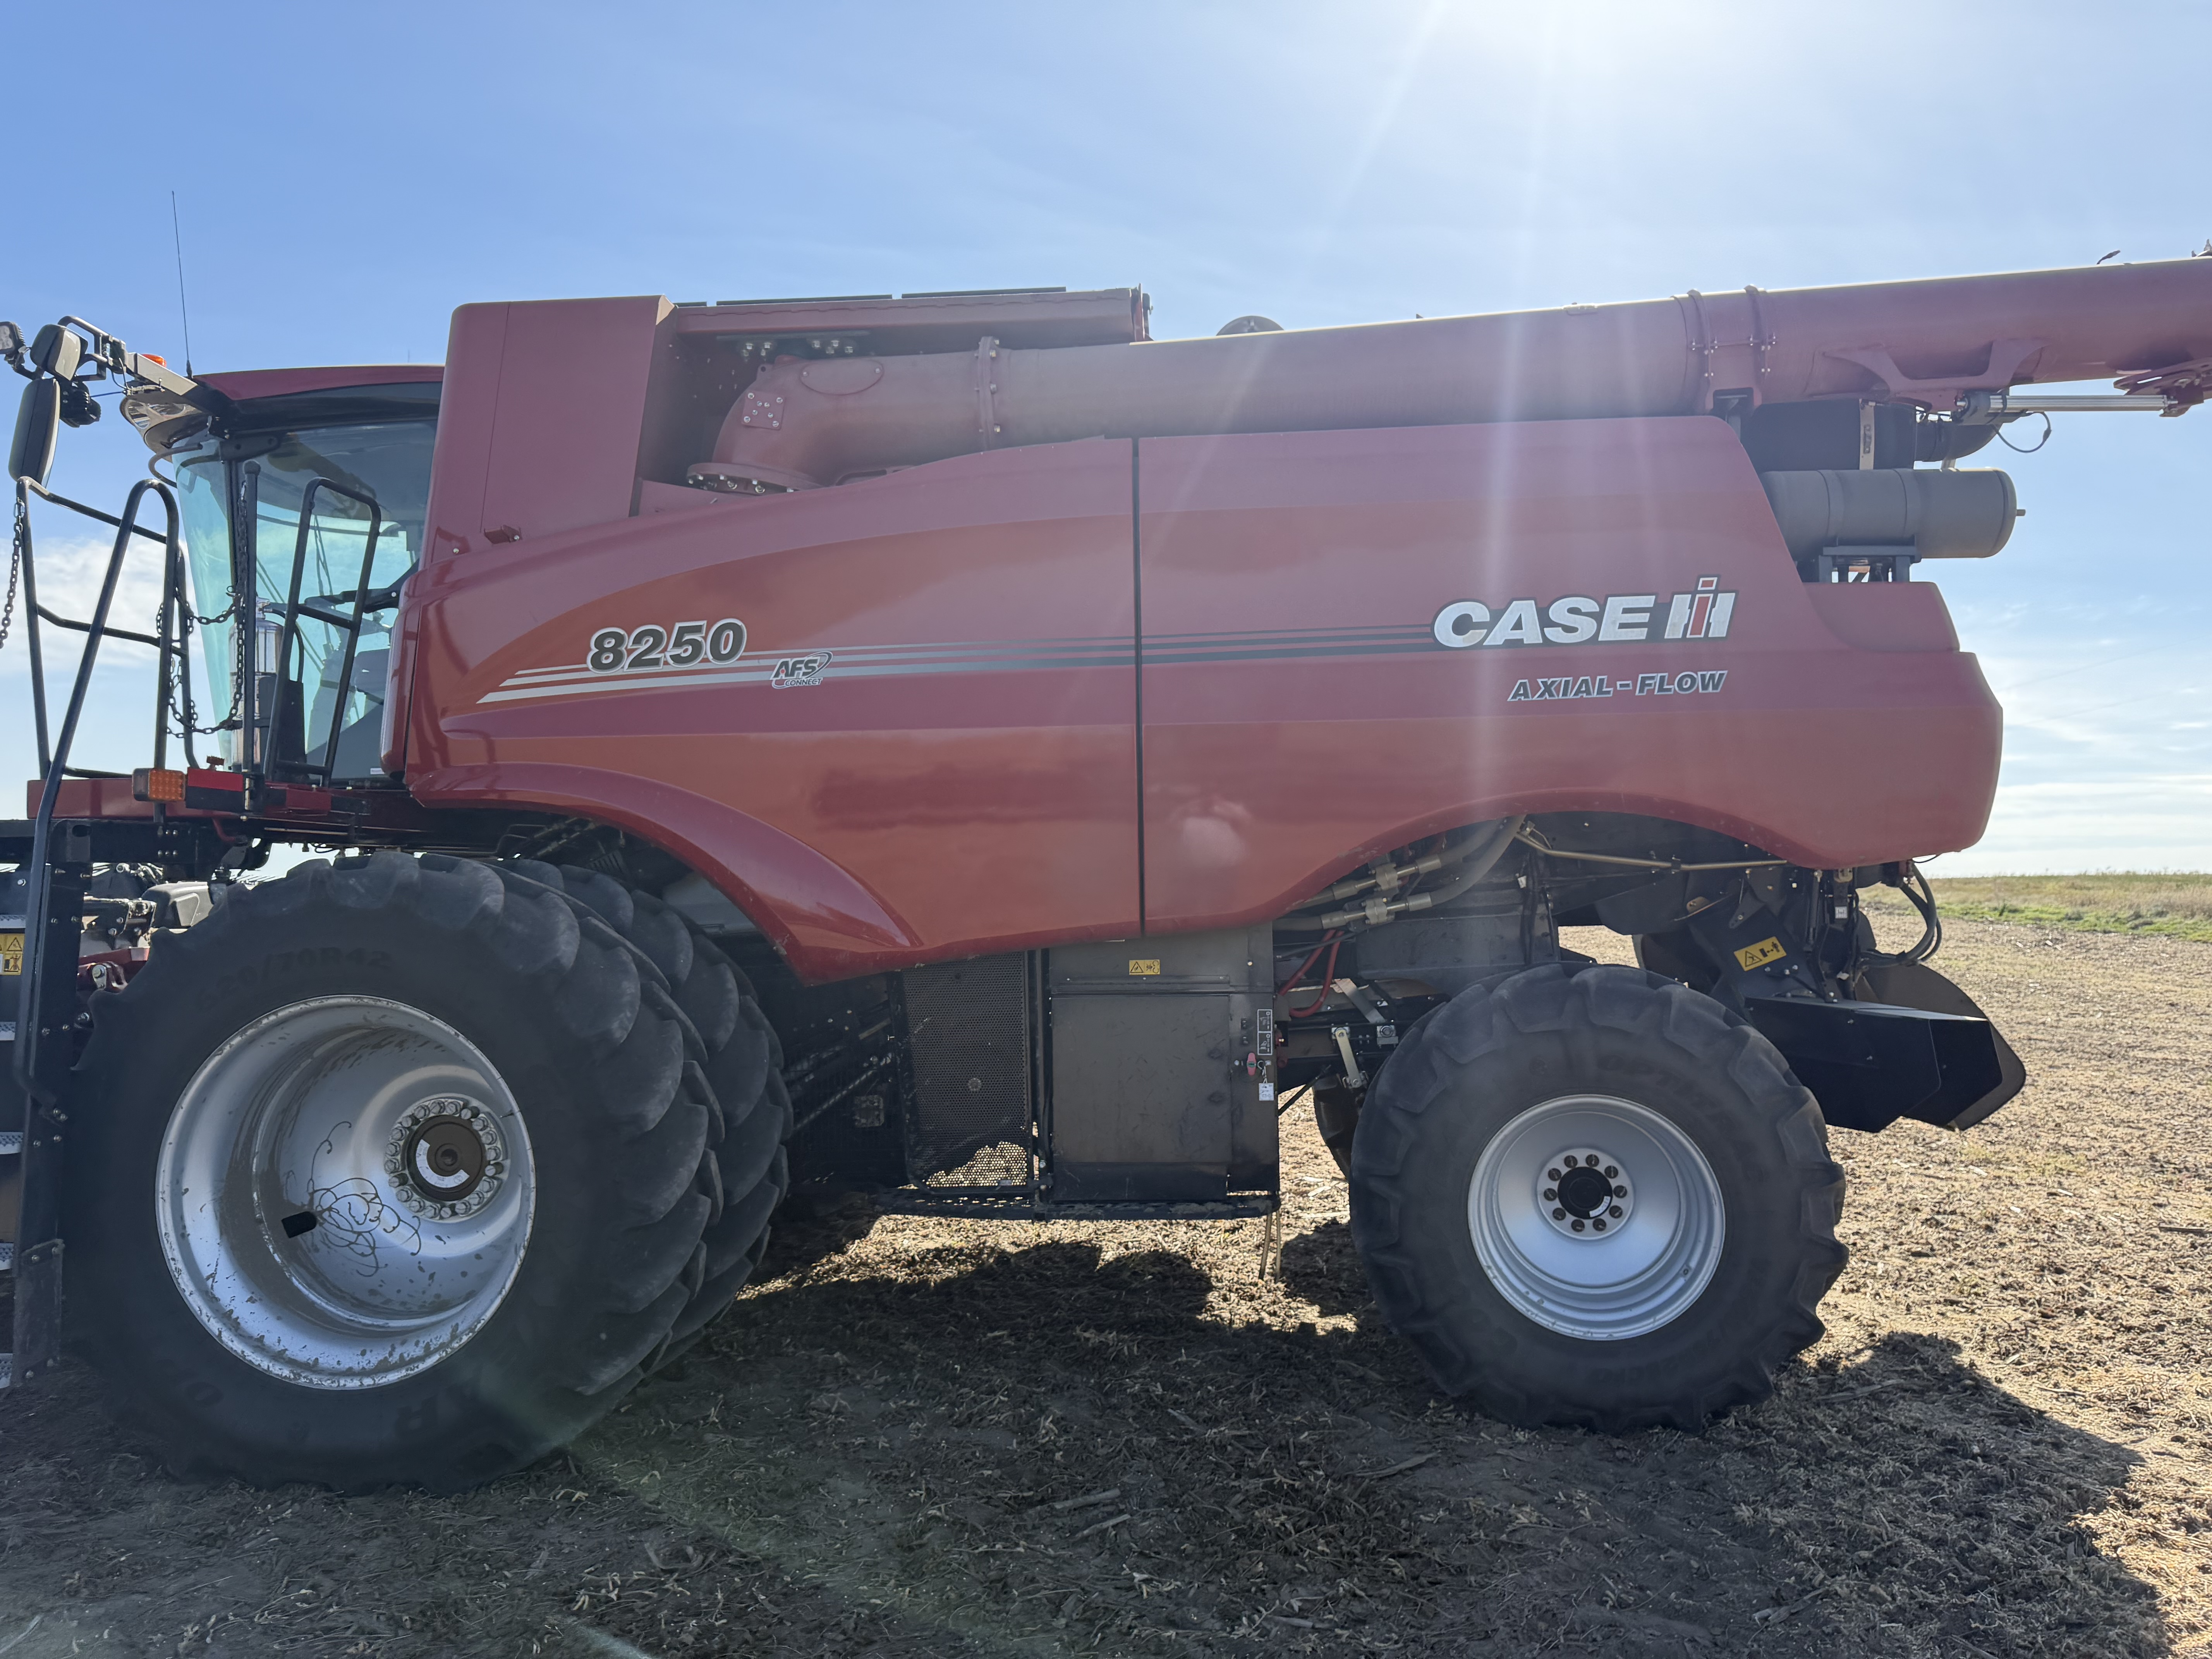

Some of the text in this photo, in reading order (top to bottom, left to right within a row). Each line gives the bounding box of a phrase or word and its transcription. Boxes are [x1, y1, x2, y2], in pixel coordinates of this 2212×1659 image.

[1434, 595, 1656, 647] CASE
[587, 619, 746, 673] 8250
[773, 658, 819, 678] AFS
[785, 678, 823, 686] CONNECT
[1508, 671, 1728, 701] AXIAL-FLOW
